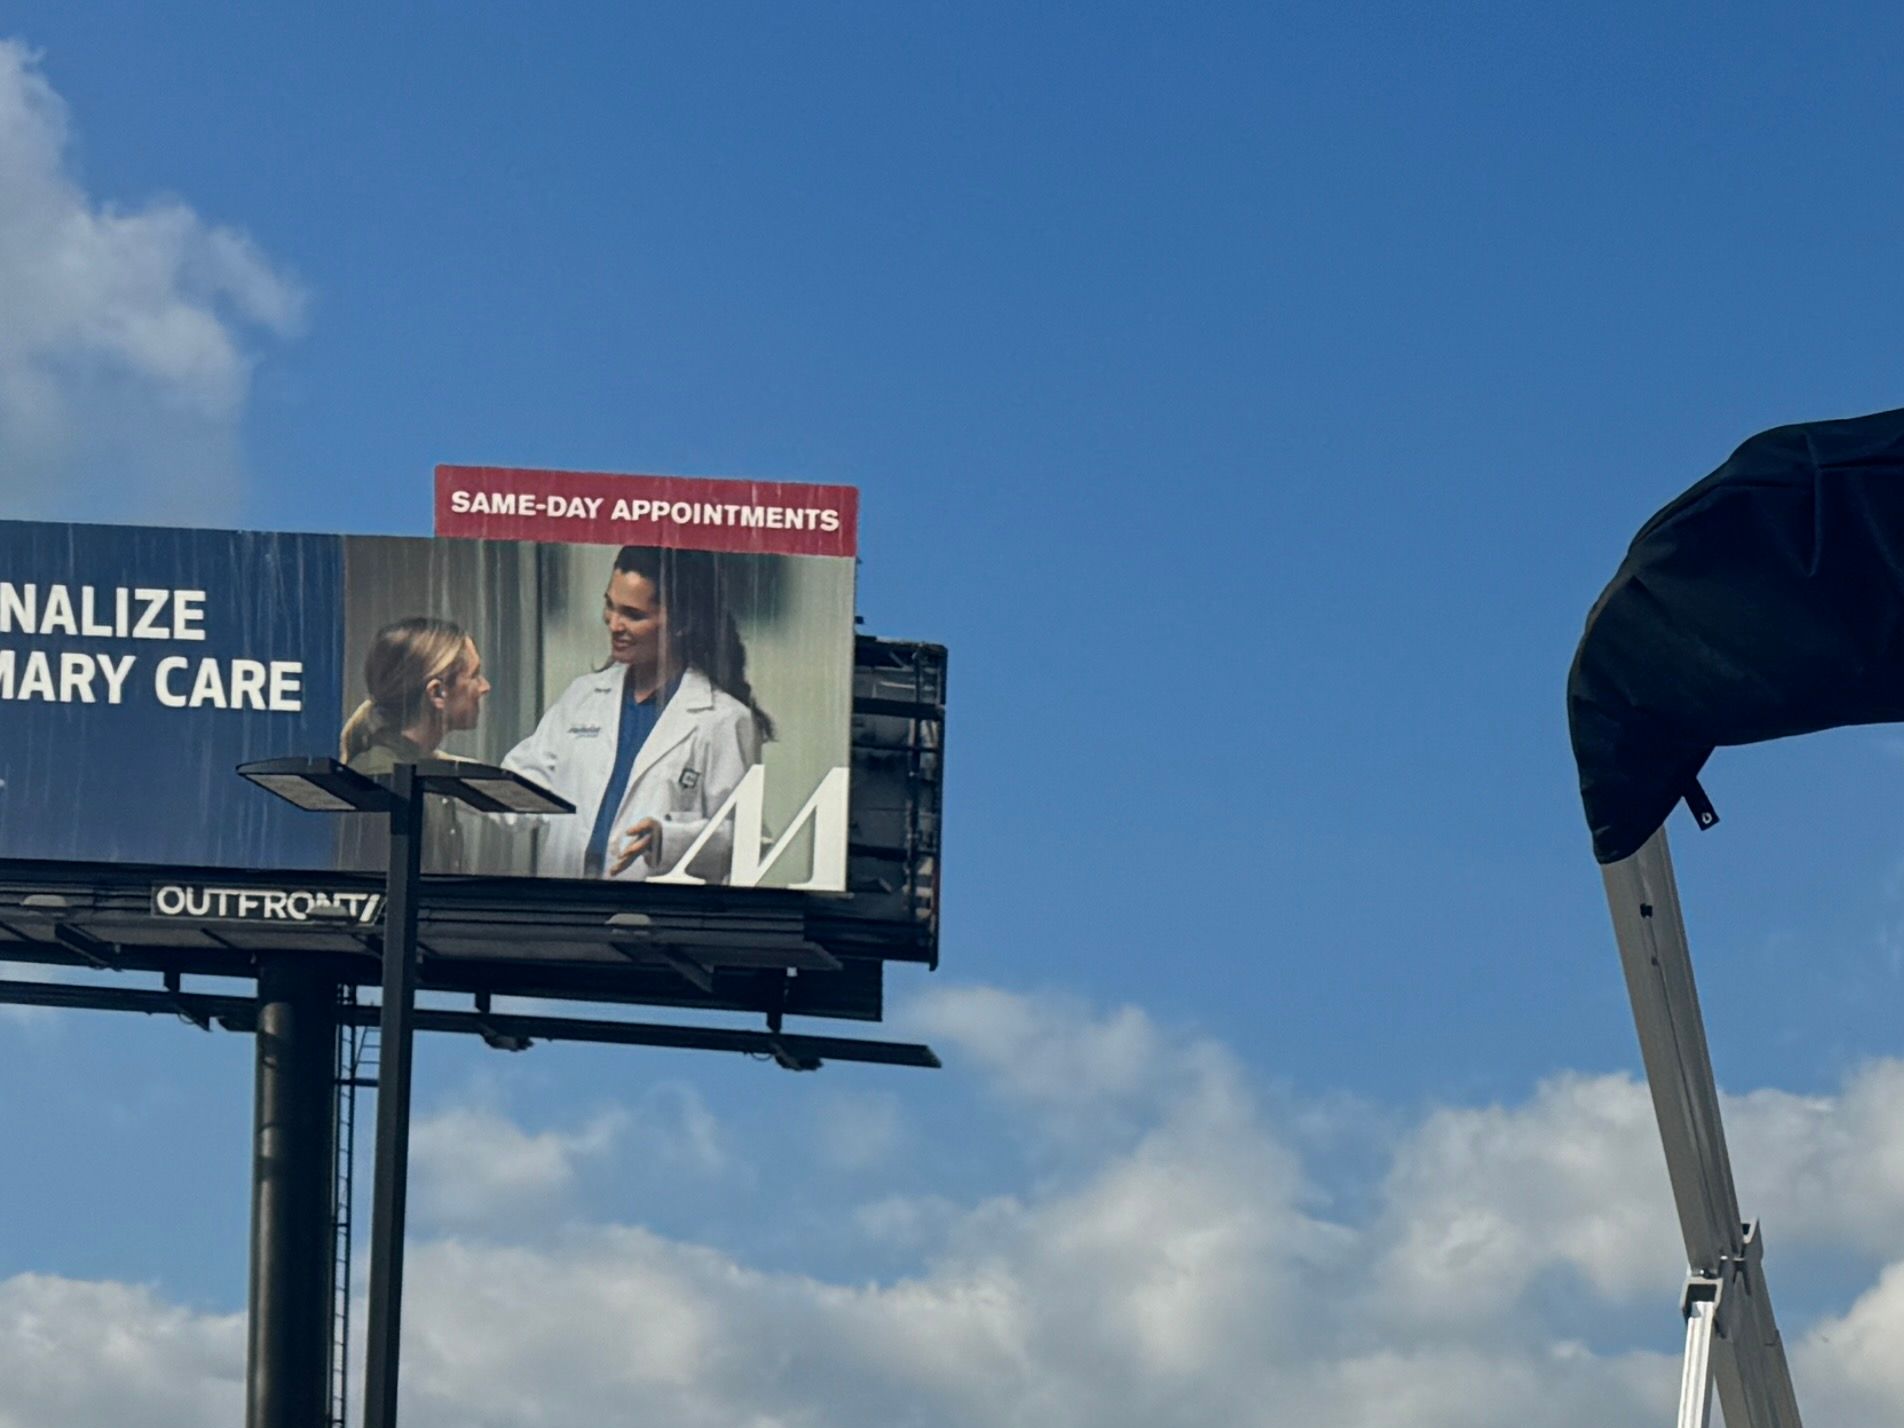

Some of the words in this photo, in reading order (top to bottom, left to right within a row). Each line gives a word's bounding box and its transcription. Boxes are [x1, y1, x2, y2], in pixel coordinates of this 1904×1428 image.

[451, 490, 604, 519] SAME-DAY
[611, 499, 840, 532] APPOINTMENTS
[0, 582, 206, 640] NALIZE
[155, 656, 303, 711] CARE
